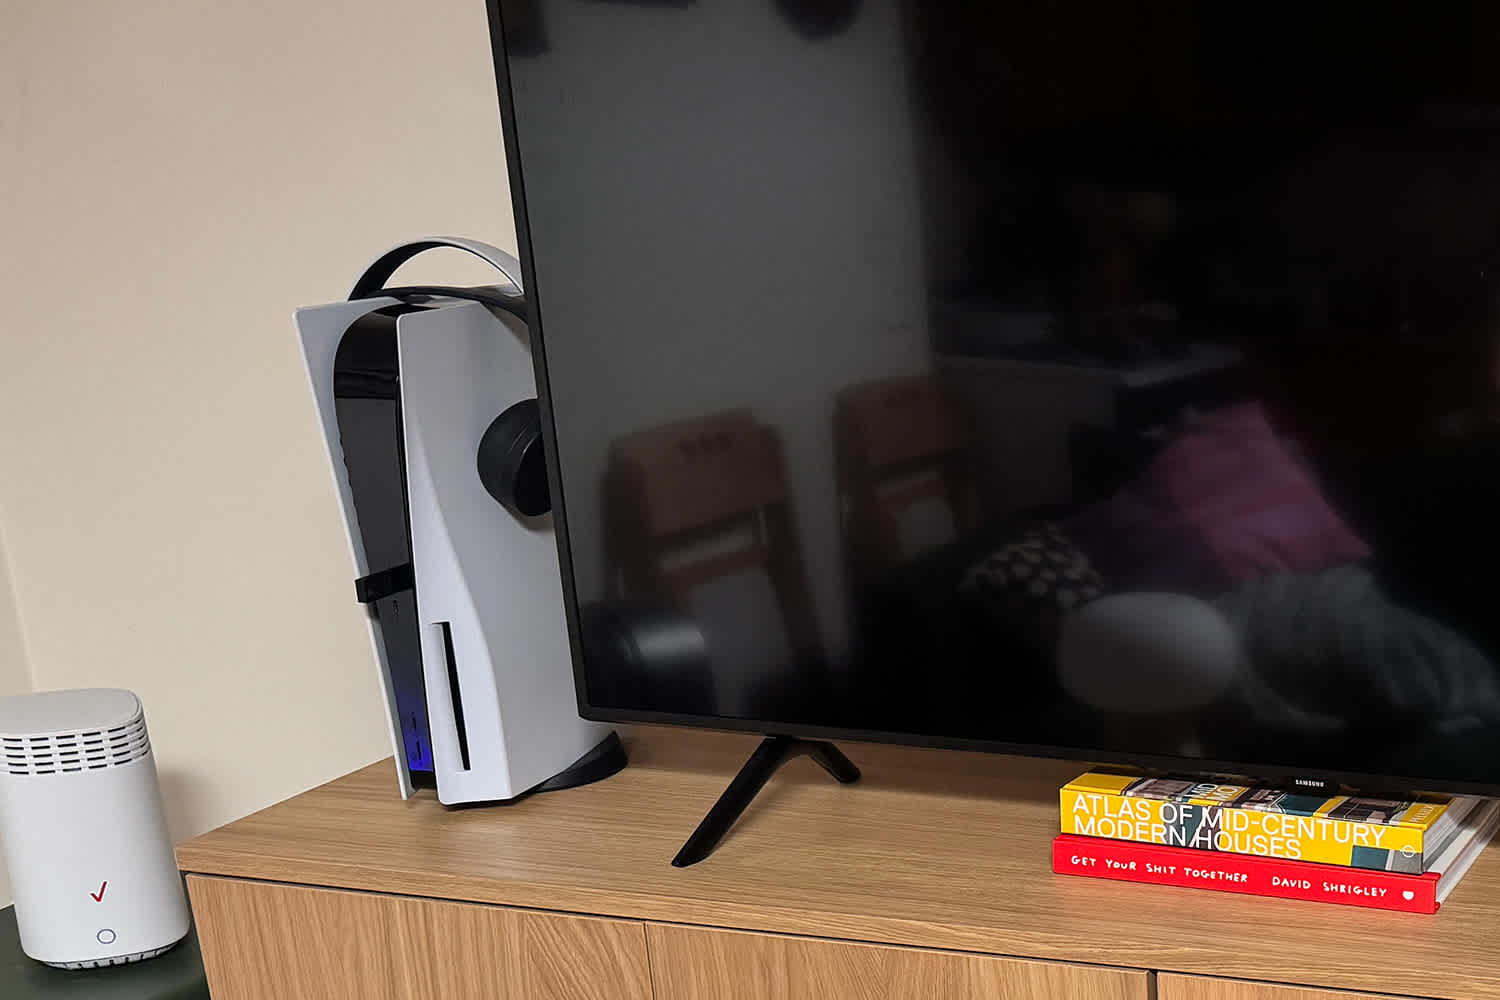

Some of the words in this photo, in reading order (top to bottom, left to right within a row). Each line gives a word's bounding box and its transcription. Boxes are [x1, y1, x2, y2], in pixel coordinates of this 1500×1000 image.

[1295, 779, 1325, 788] SAMSUNG
[1073, 793, 1151, 821] ATLAS
[1159, 802, 1193, 825] OF
[1201, 805, 1386, 847] MID-CENTURY
[1074, 815, 1186, 847] MODERN
[1195, 827, 1301, 859] HOUSES
[1071, 855, 1096, 867] GET
[1146, 863, 1177, 875] SHIT
[1184, 867, 1248, 883] TOGETHER
[1272, 876, 1311, 889] DAVID
[1323, 882, 1387, 897] SHRIGLEY
